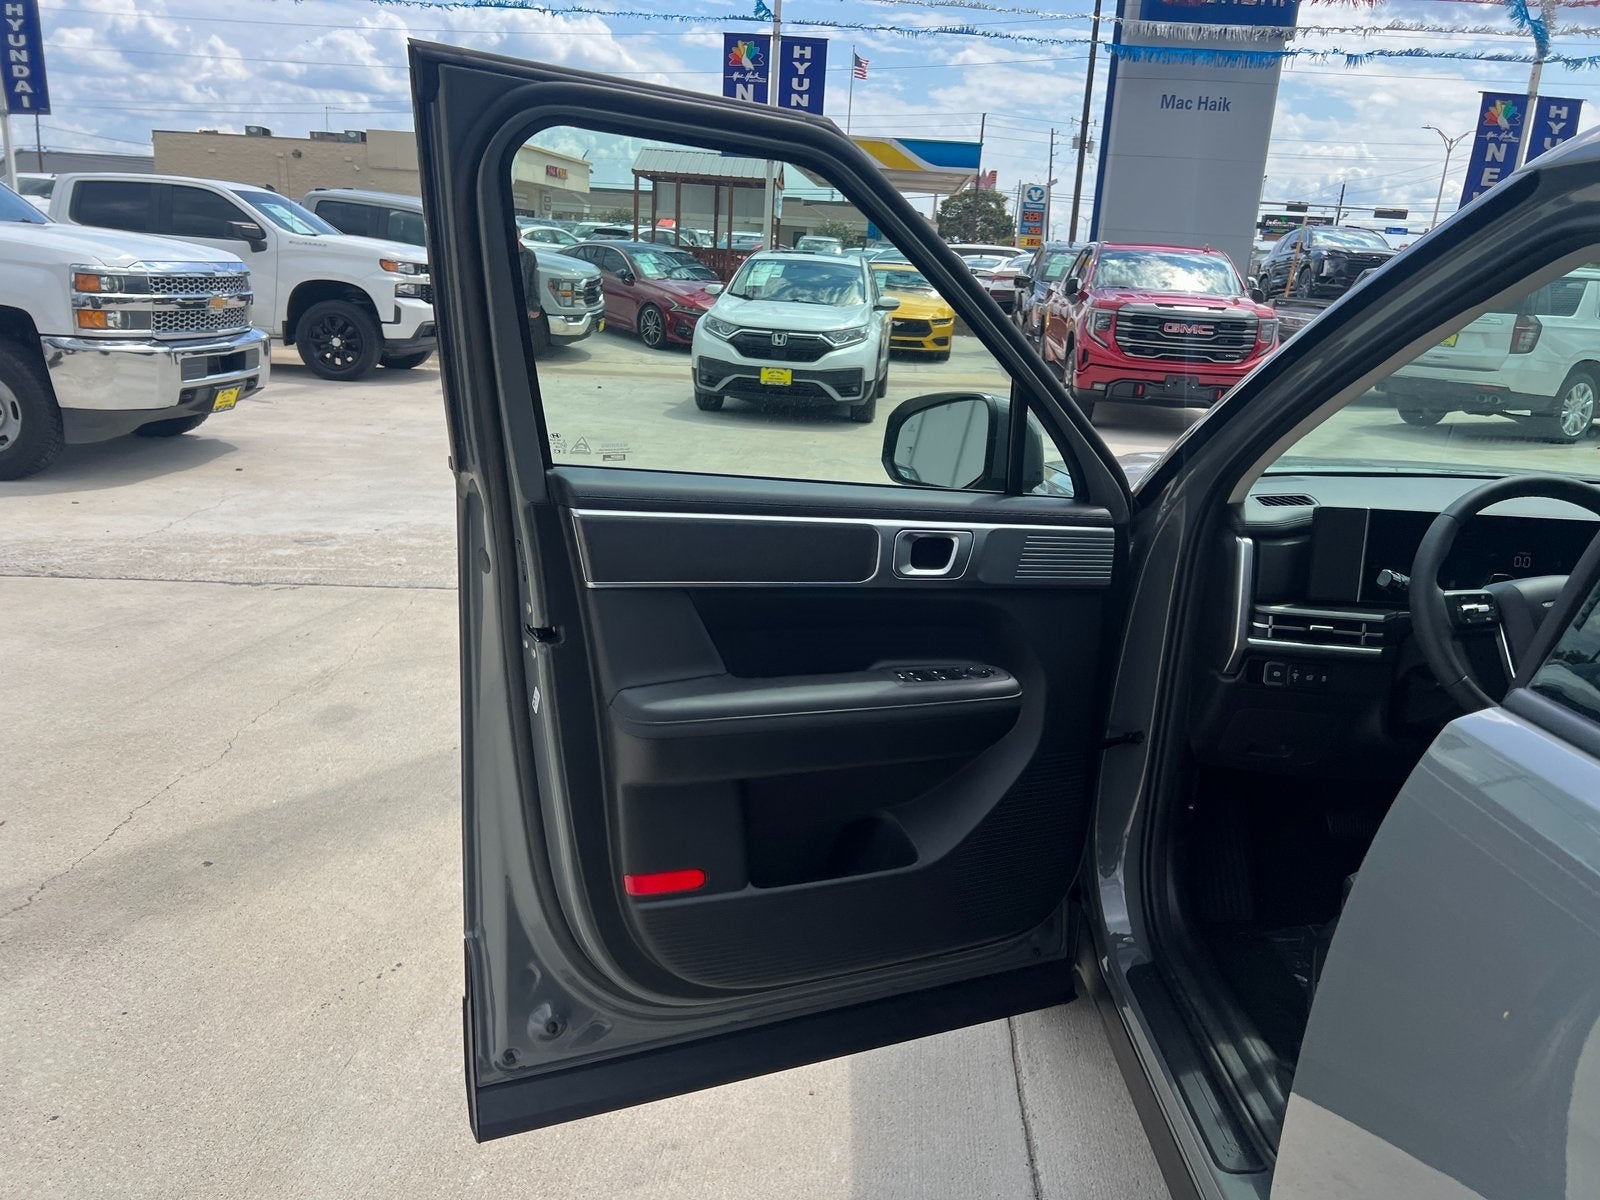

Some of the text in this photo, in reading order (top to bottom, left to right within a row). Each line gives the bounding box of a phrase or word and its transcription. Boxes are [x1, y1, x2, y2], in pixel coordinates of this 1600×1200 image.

[5, 3, 34, 108] HYUNDAI
[1160, 94, 1232, 112] Mac Haik
[1163, 322, 1215, 335] GMC
